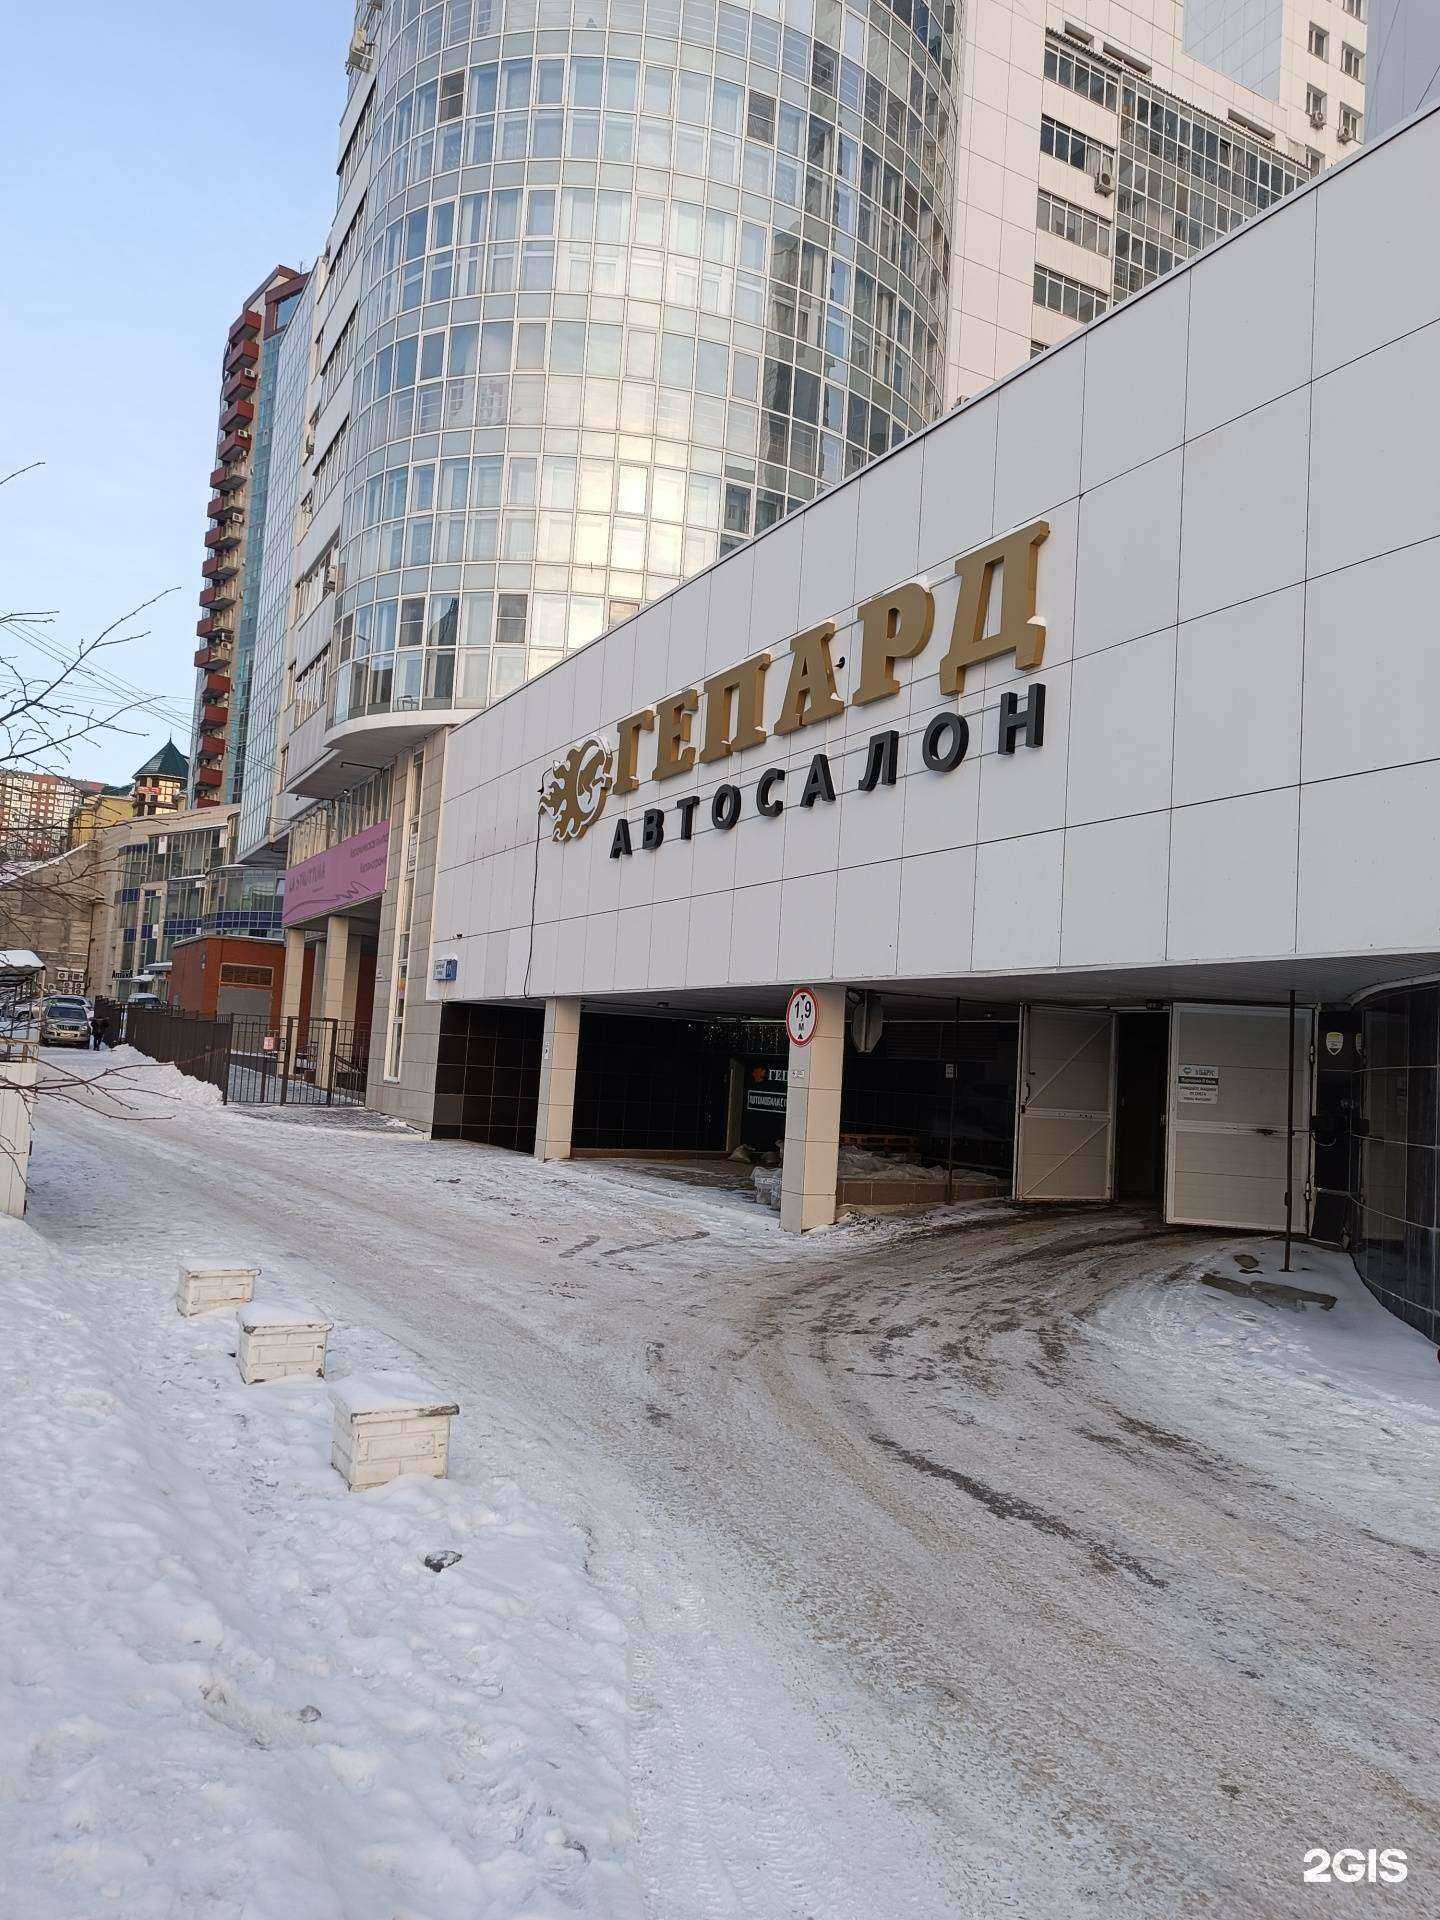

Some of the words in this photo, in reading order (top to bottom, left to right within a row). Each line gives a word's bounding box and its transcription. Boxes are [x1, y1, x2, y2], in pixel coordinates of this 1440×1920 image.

[612, 520, 1050, 795] ГЕПАРД
[610, 682, 1046, 859] АВТОСАЛОН
[795, 1001, 811, 1021] 1,9
